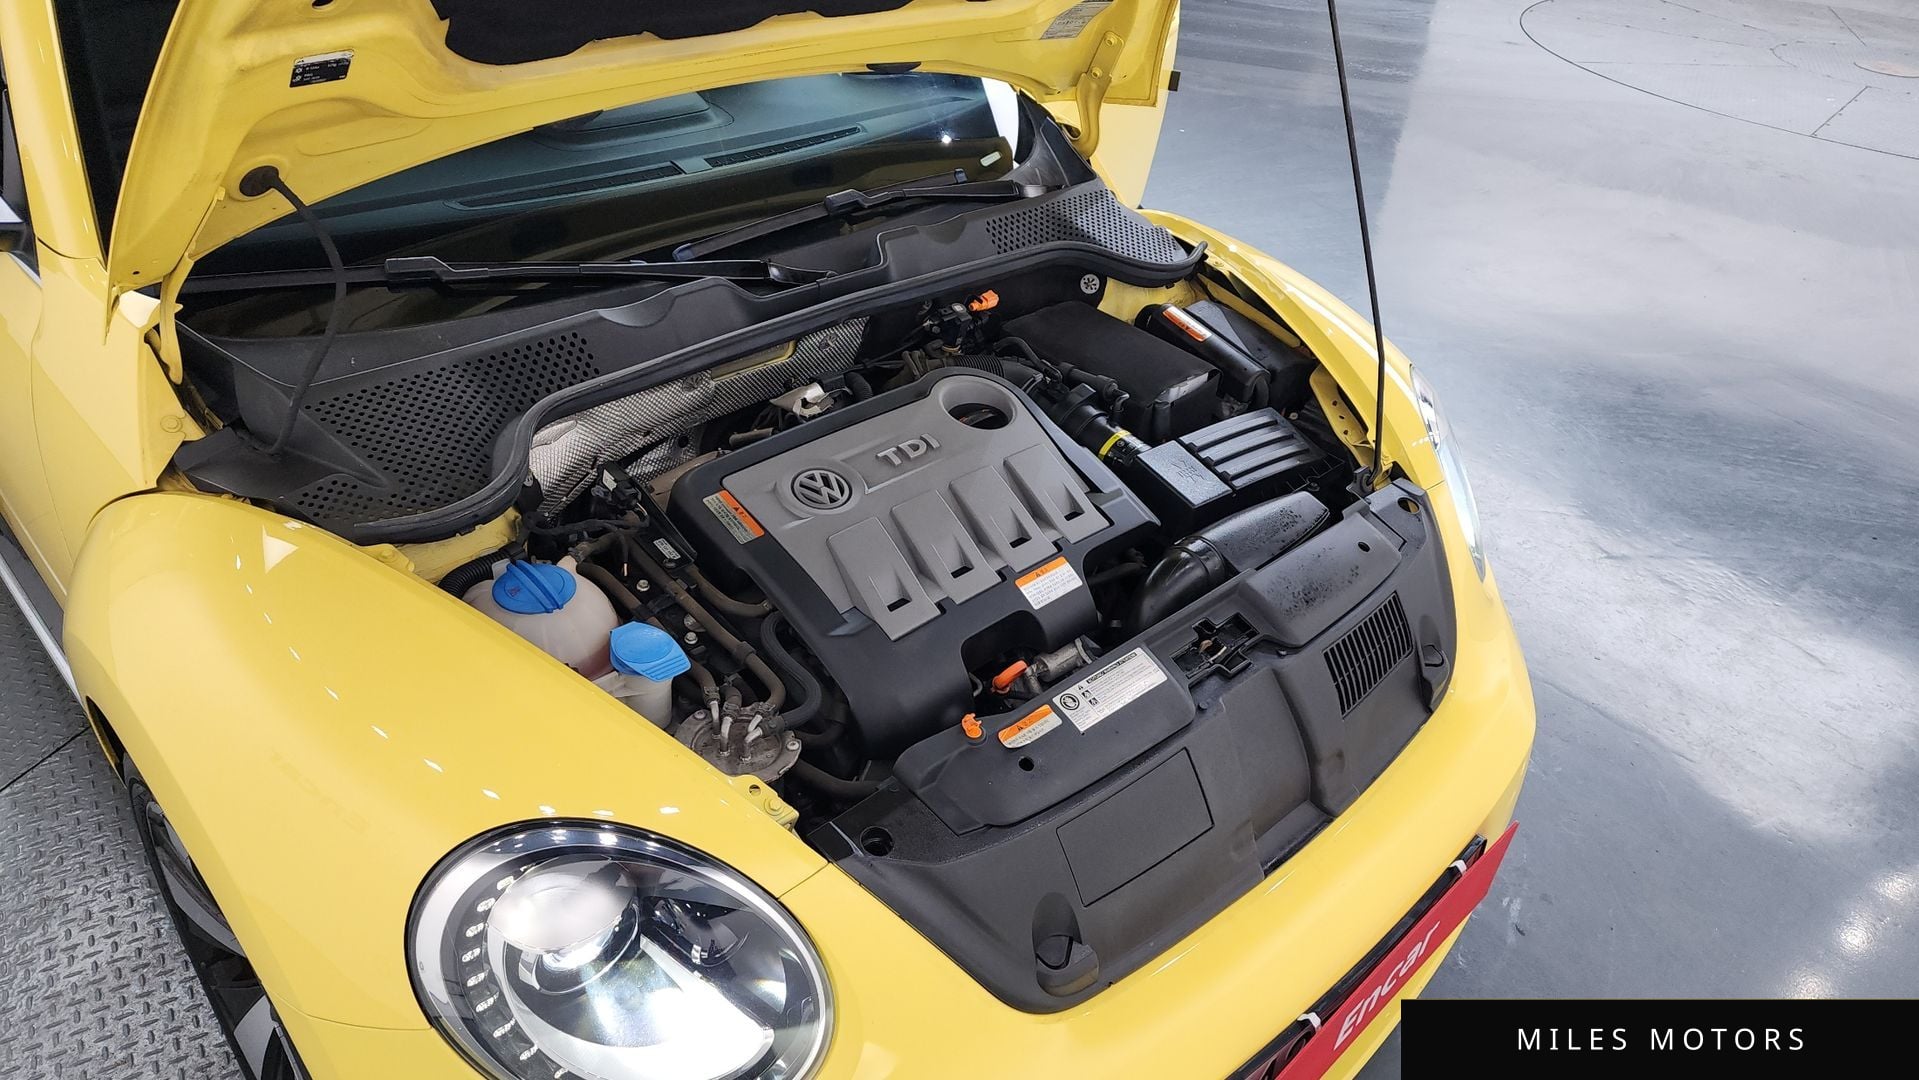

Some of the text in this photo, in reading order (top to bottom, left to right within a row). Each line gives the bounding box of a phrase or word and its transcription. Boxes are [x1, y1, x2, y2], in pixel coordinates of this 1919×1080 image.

[876, 433, 941, 466] TDI
[793, 469, 850, 508] VW
[1333, 921, 1440, 1051] Encar
